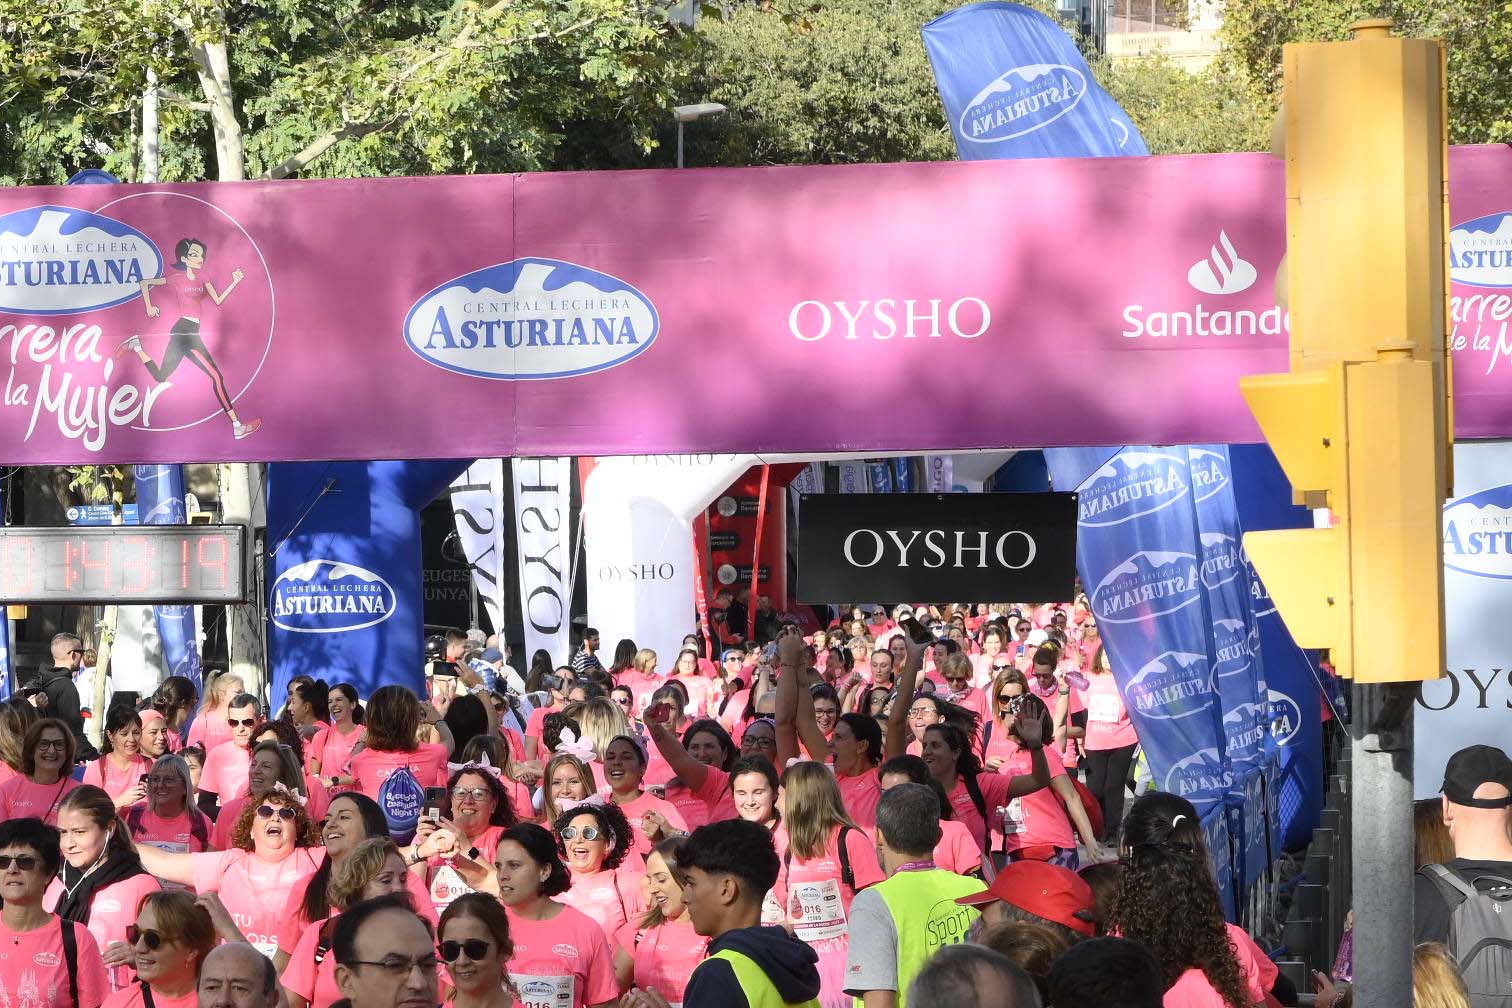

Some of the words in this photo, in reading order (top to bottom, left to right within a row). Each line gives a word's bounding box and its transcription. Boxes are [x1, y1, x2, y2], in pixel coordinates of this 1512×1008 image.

[66, 242, 138, 253] LECHERA
[1462, 238, 1512, 247] CENTRA
[463, 301, 541, 313] CENTRAL
[550, 298, 630, 311] LECHERA
[789, 297, 990, 342] OYSHO
[1449, 294, 1512, 325] arre
[423, 304, 639, 350] ASTURIANA
[1122, 305, 1290, 337] Santand
[1473, 323, 1491, 352] la
[4, 366, 29, 406] la
[23, 358, 174, 452] Mujer
[1470, 516, 1512, 527] CENT
[843, 528, 1037, 569] OYSHO
[274, 589, 387, 617] ASTURIANA
[287, 585, 329, 593] CENTRAL
[332, 584, 382, 592] LECHERA
[804, 905, 821, 915] 016
[927, 907, 971, 946] Sport
